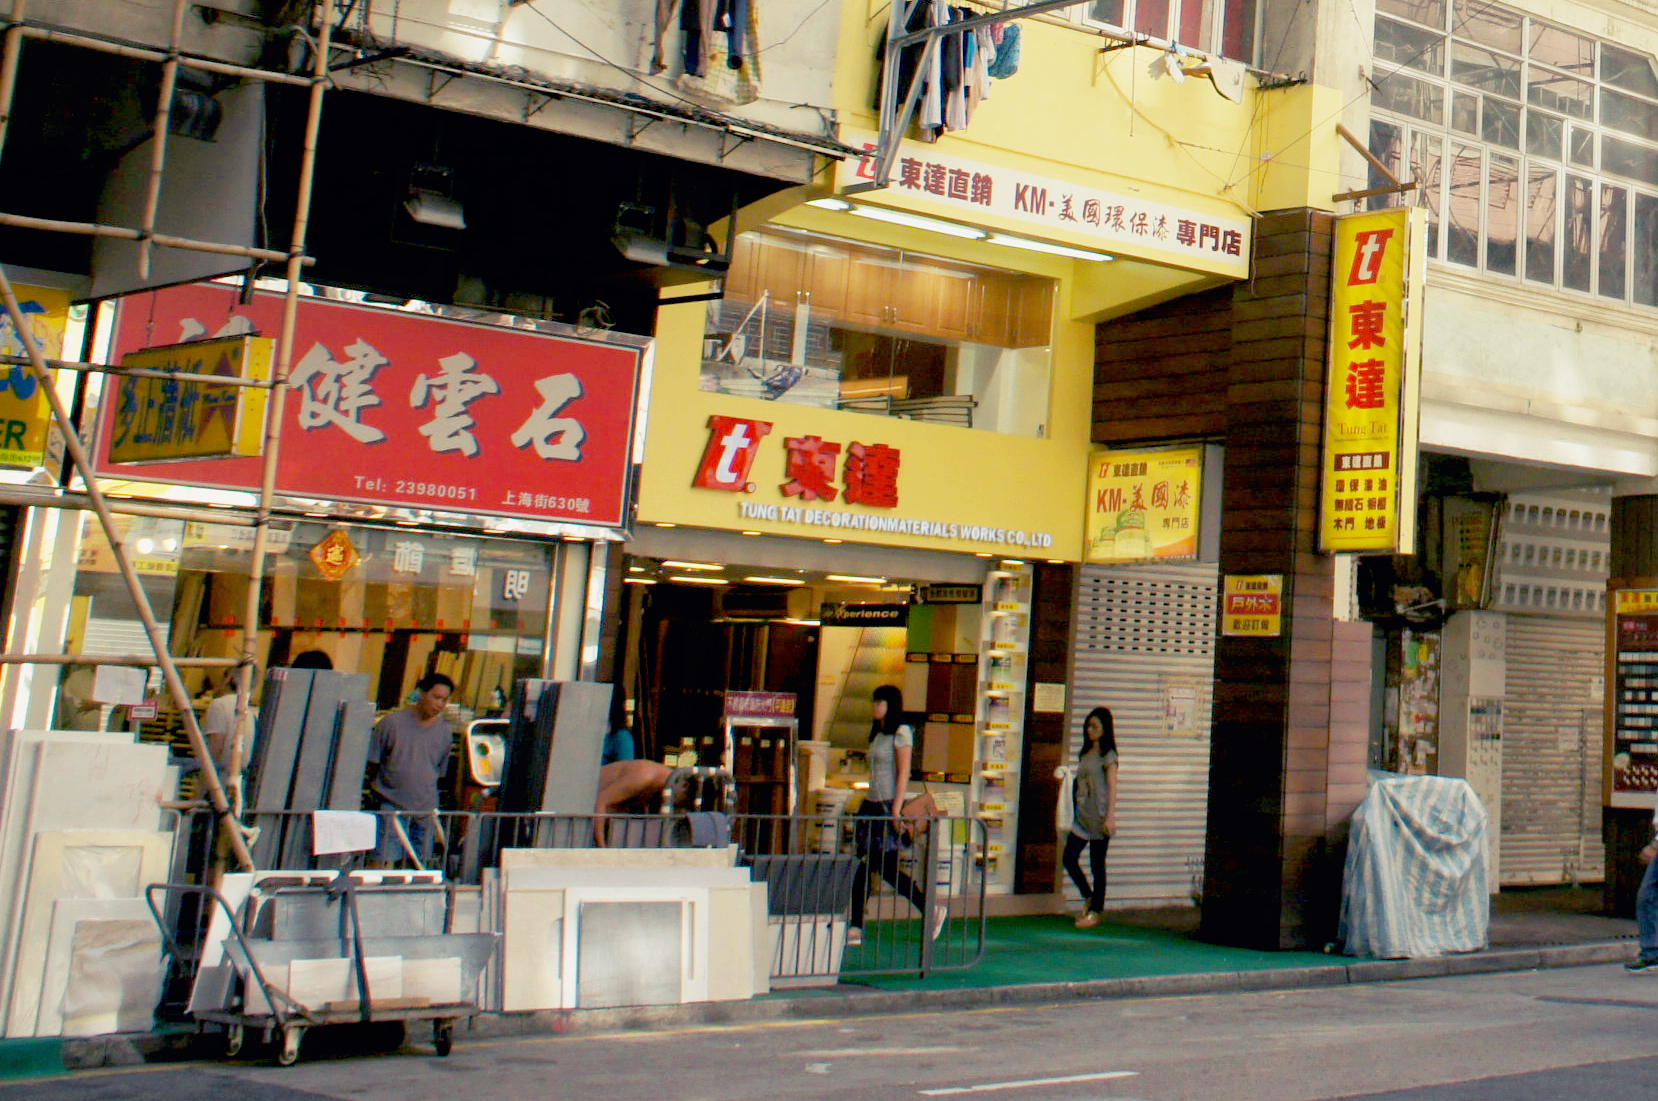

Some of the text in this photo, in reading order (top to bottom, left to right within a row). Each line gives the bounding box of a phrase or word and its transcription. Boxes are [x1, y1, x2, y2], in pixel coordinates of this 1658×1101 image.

[900, 157, 993, 206] 東達直銷
[1176, 218, 1242, 257] 專門店
[1346, 298, 1387, 410] 東達
[354, 475, 477, 500] Tel: 23980051
[778, 434, 901, 509] 東達
[738, 501, 778, 522] TUNG
[780, 505, 803, 524] TAT
[960, 522, 1006, 545] WORKS
